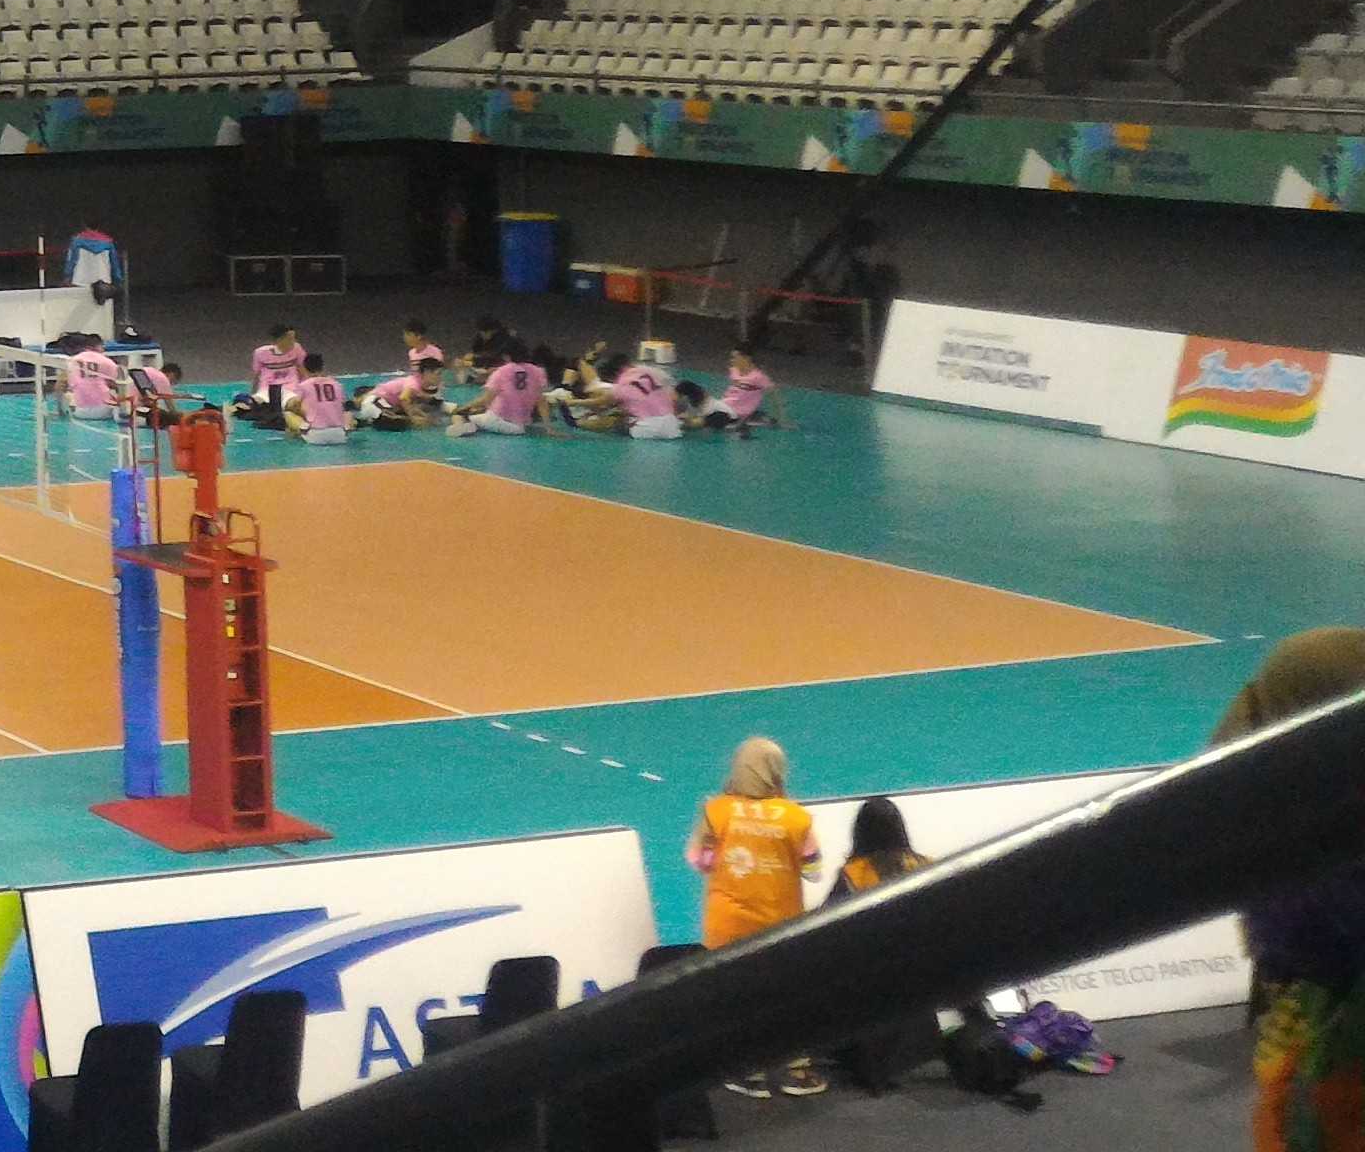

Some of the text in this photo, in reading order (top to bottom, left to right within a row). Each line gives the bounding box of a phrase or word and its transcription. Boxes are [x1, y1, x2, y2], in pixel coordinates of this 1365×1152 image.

[313, 383, 336, 402] 10
[1030, 955, 1238, 995] ESTIGE TELCO PARTNER
